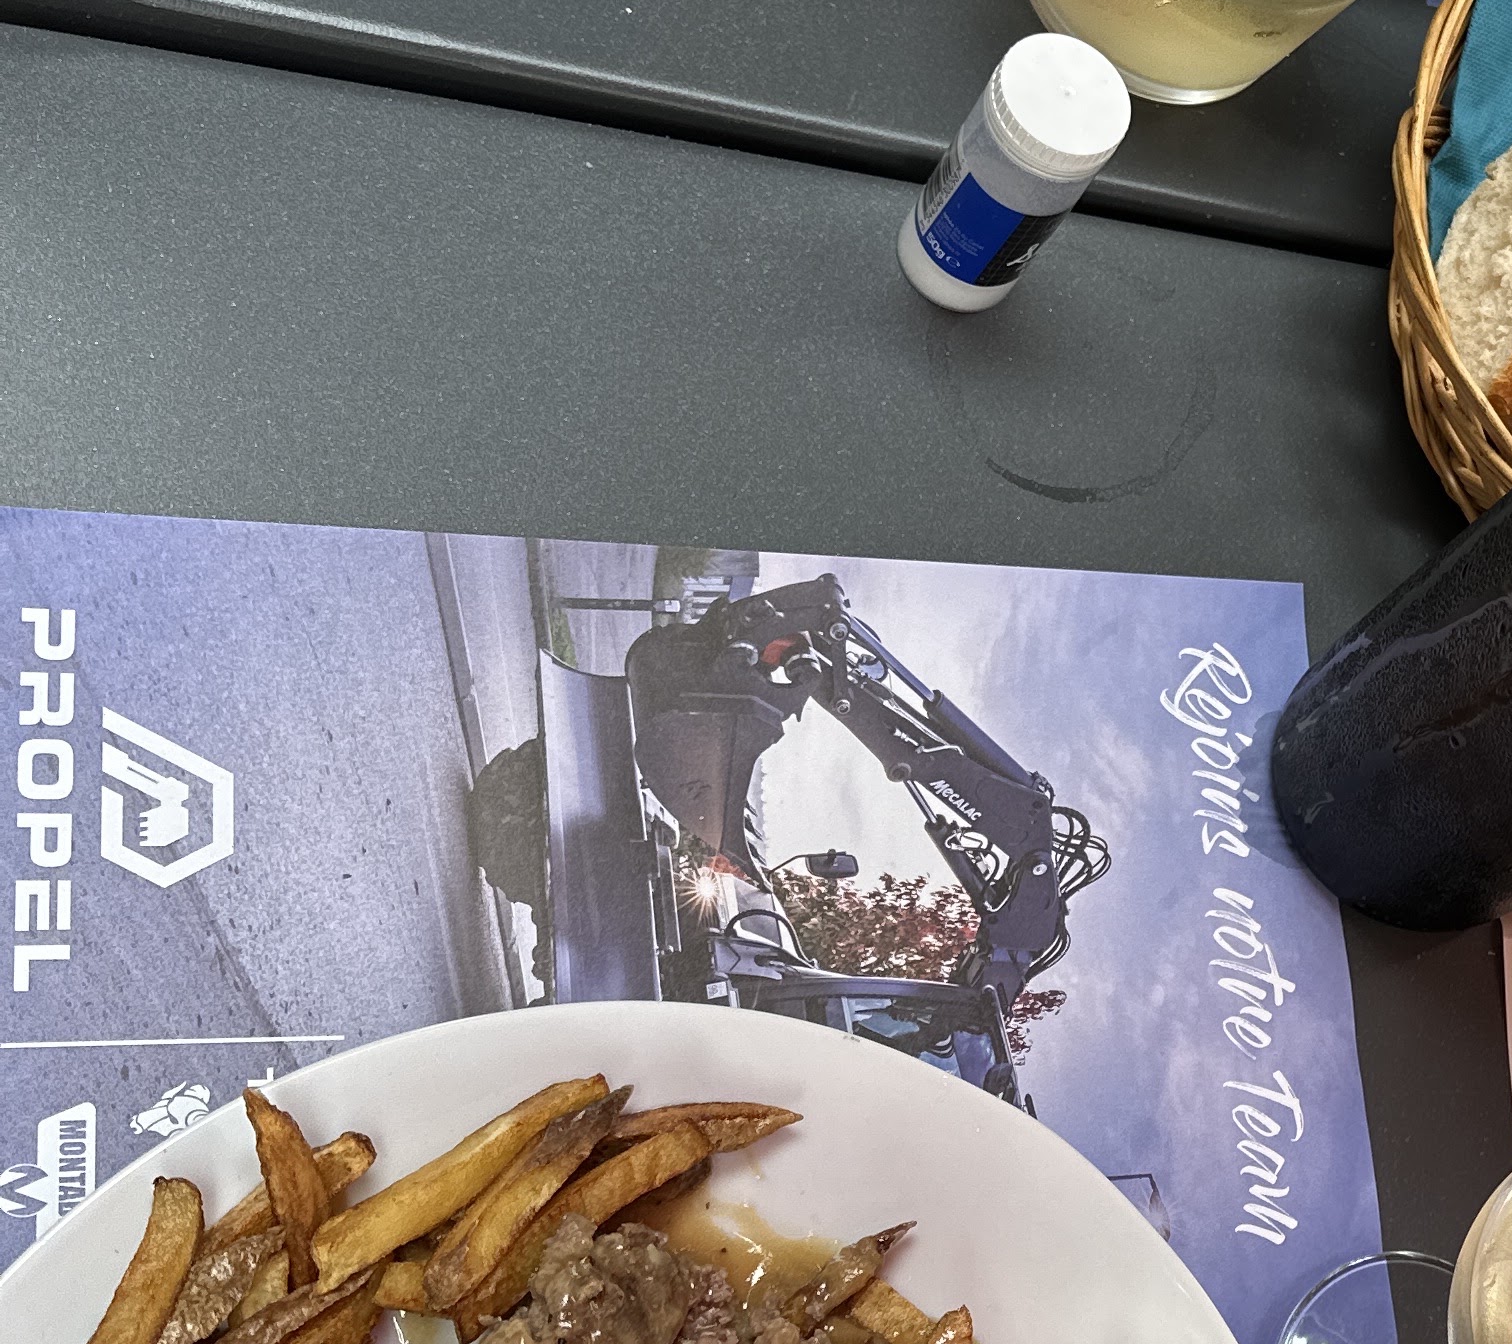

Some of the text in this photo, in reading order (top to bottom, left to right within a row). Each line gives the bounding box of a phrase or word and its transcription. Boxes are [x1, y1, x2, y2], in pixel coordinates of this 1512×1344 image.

[13, 607, 76, 992] PROPEL
[1160, 640, 1307, 1246] Rejoins notre Team
